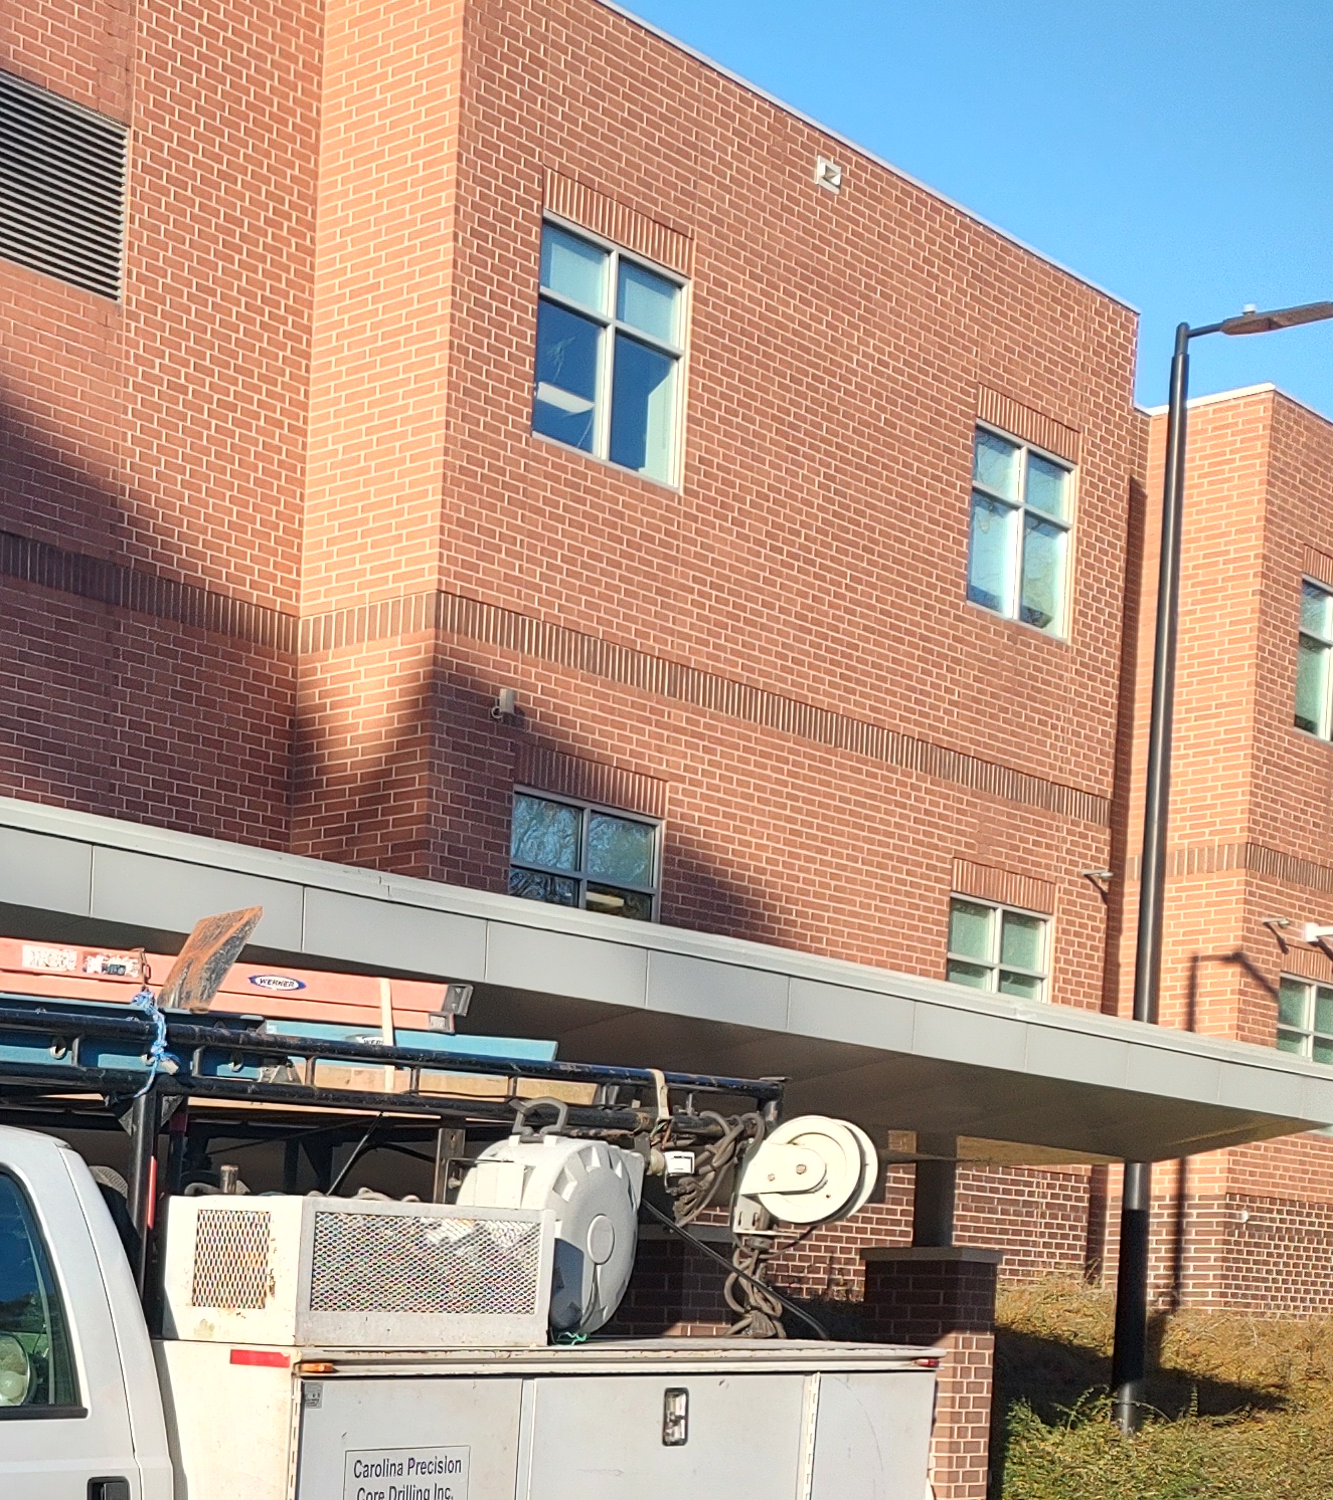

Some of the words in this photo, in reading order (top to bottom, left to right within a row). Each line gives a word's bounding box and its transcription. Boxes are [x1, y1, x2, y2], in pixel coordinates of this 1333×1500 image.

[259, 978, 295, 988] WERNER
[353, 1458, 403, 1479] Carolina
[407, 1456, 462, 1476] Precision
[433, 1483, 454, 1500] Inc.
